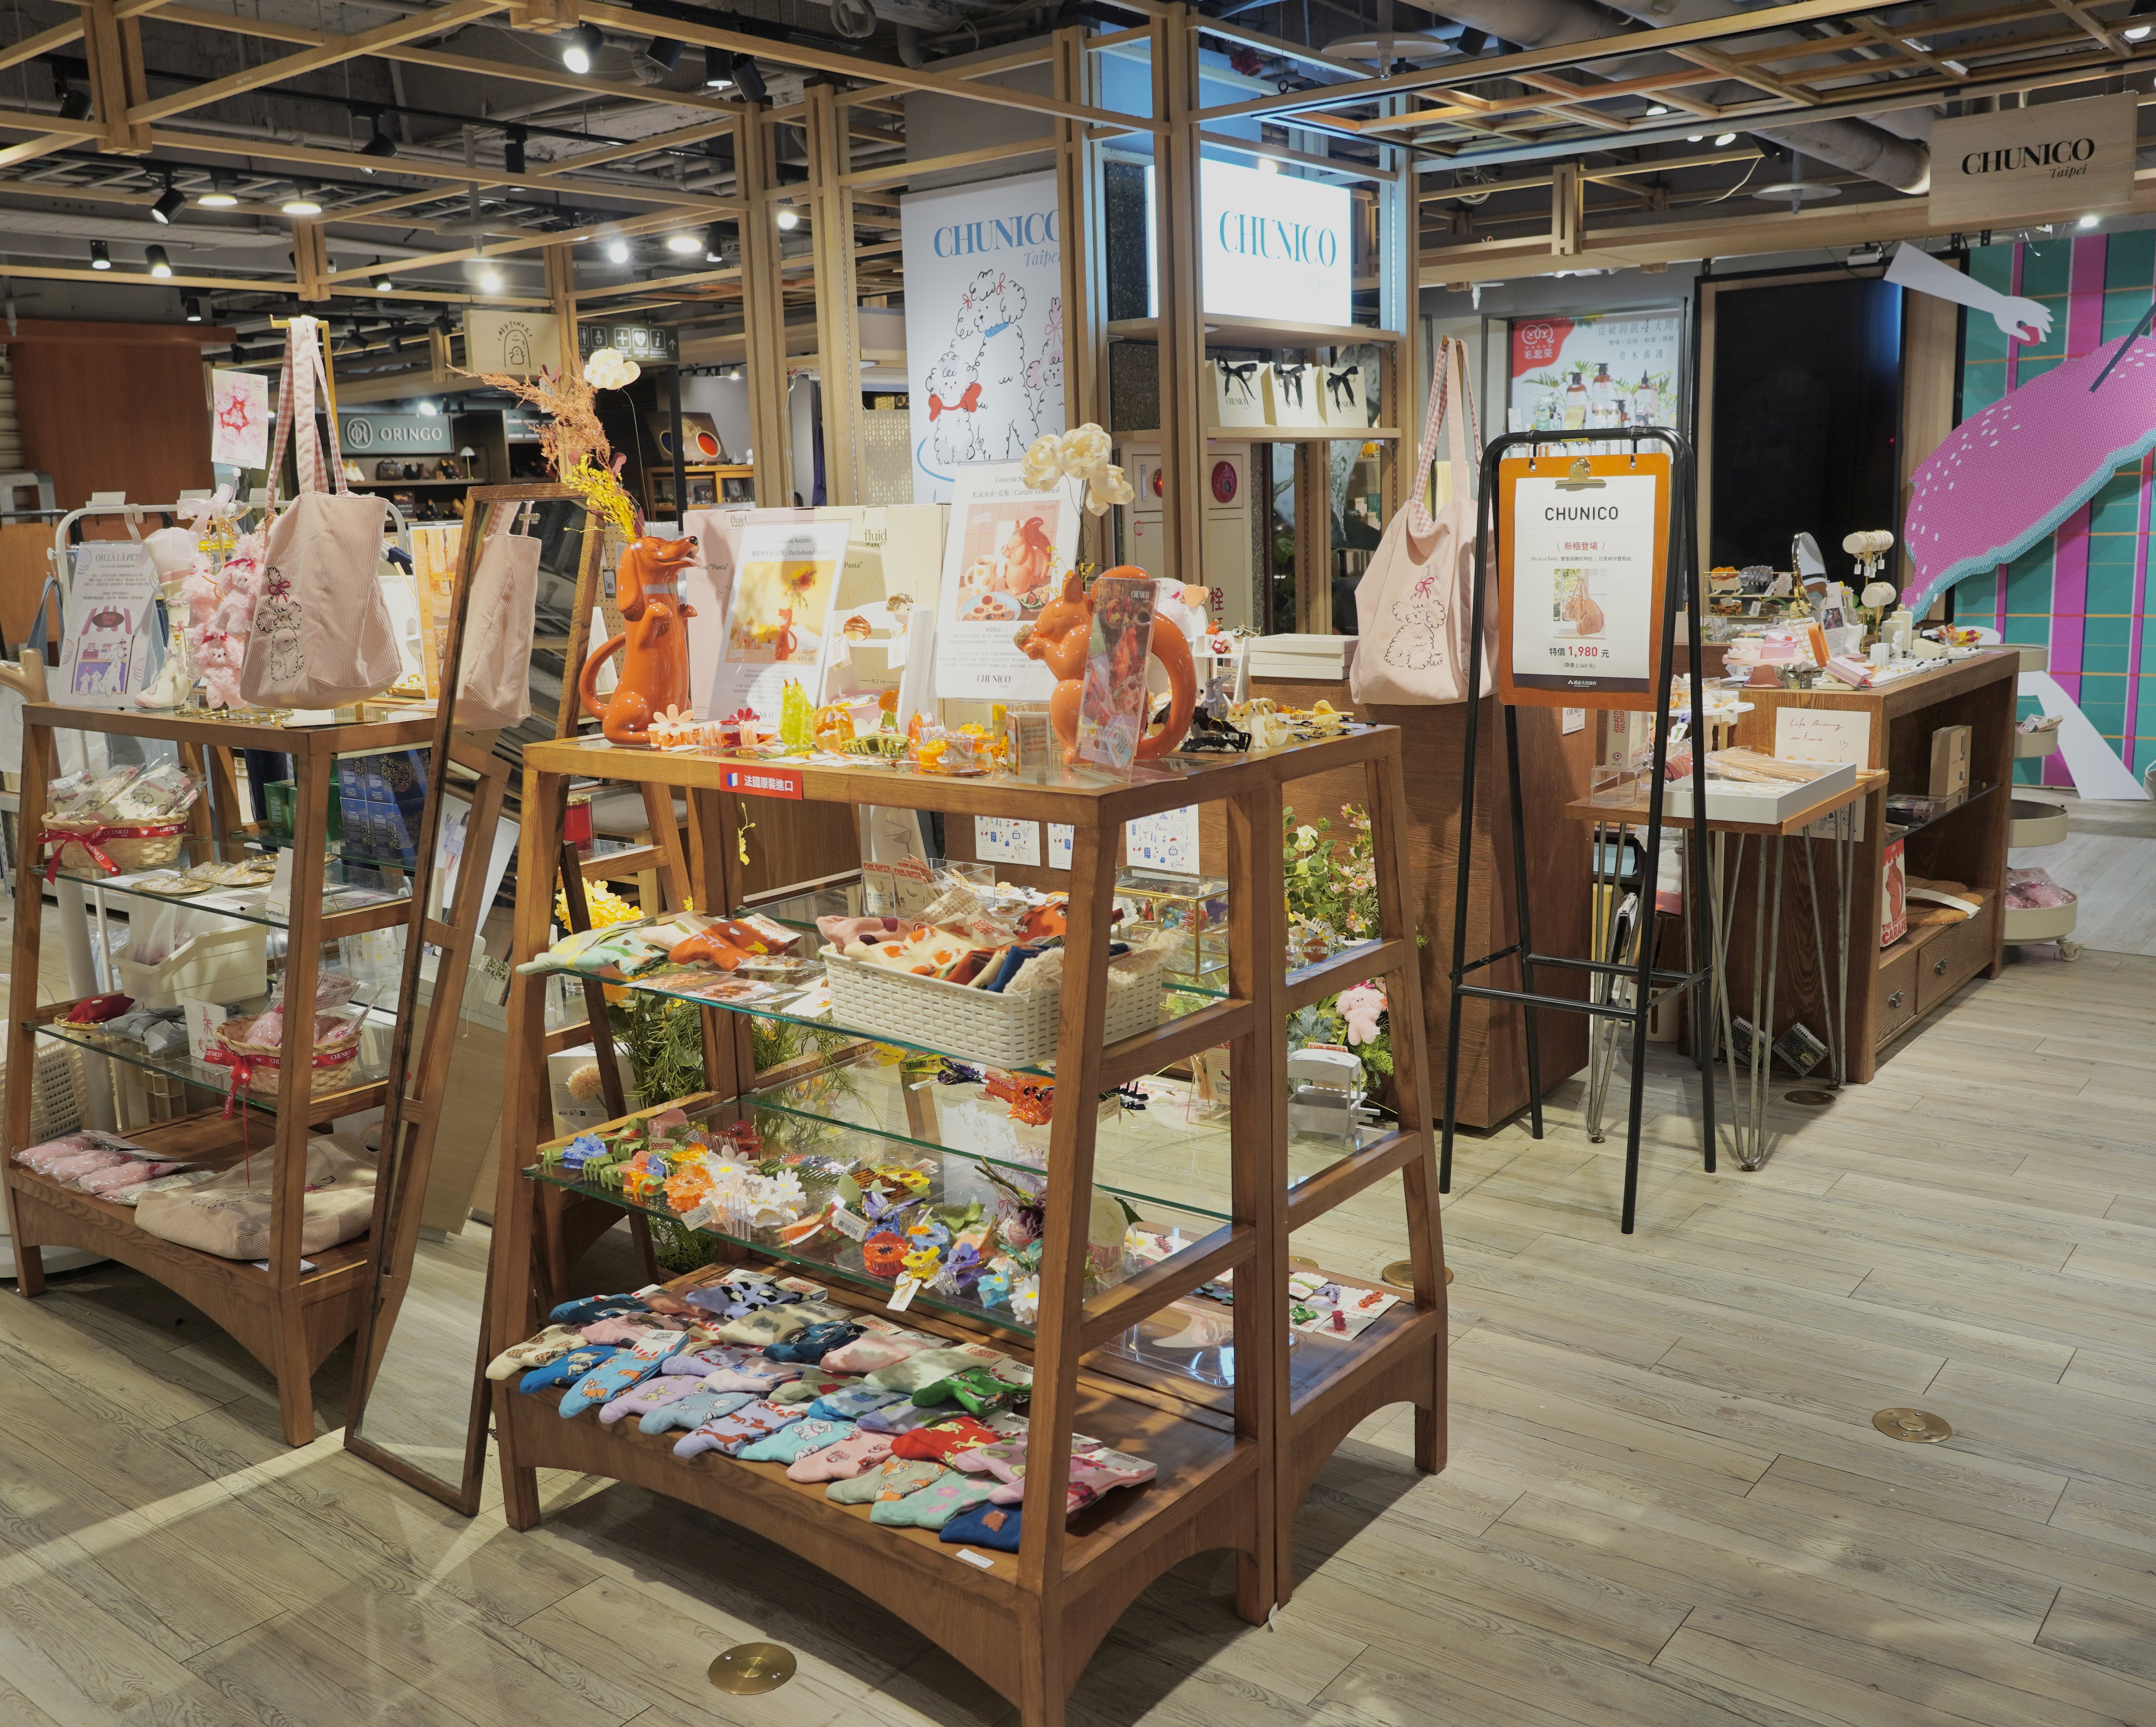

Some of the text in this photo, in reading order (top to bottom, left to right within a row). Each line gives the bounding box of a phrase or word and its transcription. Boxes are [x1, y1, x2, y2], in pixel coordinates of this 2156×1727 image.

[1962, 138, 2095, 175] CHUNICO
[2050, 164, 2087, 179] Taipei
[1219, 211, 1336, 267] CHUNICO
[1525, 349, 1553, 360] 毛起來
[1620, 349, 1663, 361] 草本養護
[380, 427, 443, 441] ORINGO
[730, 515, 747, 524] fluid
[1545, 506, 1619, 521] CHUNICO
[864, 528, 887, 541] fluid
[1564, 542, 1598, 550] 新櫃登場
[1550, 648, 1565, 656] 特價
[1568, 646, 1597, 658] 1,980
[977, 675, 1011, 683] CHUNICO
[1811, 720, 1844, 731] Arriving
[744, 774, 794, 793] 法國原裝進口
[756, 921, 788, 936] suzette
[761, 920, 791, 934] coucou
[978, 919, 1008, 937] coucou
[1882, 922, 1891, 932] THE
[1882, 921, 1907, 945] CARAFE
[331, 1050, 351, 1060] CHUNICO
[790, 1281, 817, 1290] coucou
[868, 1320, 893, 1330] coucou
[969, 1346, 1000, 1356] coucou
